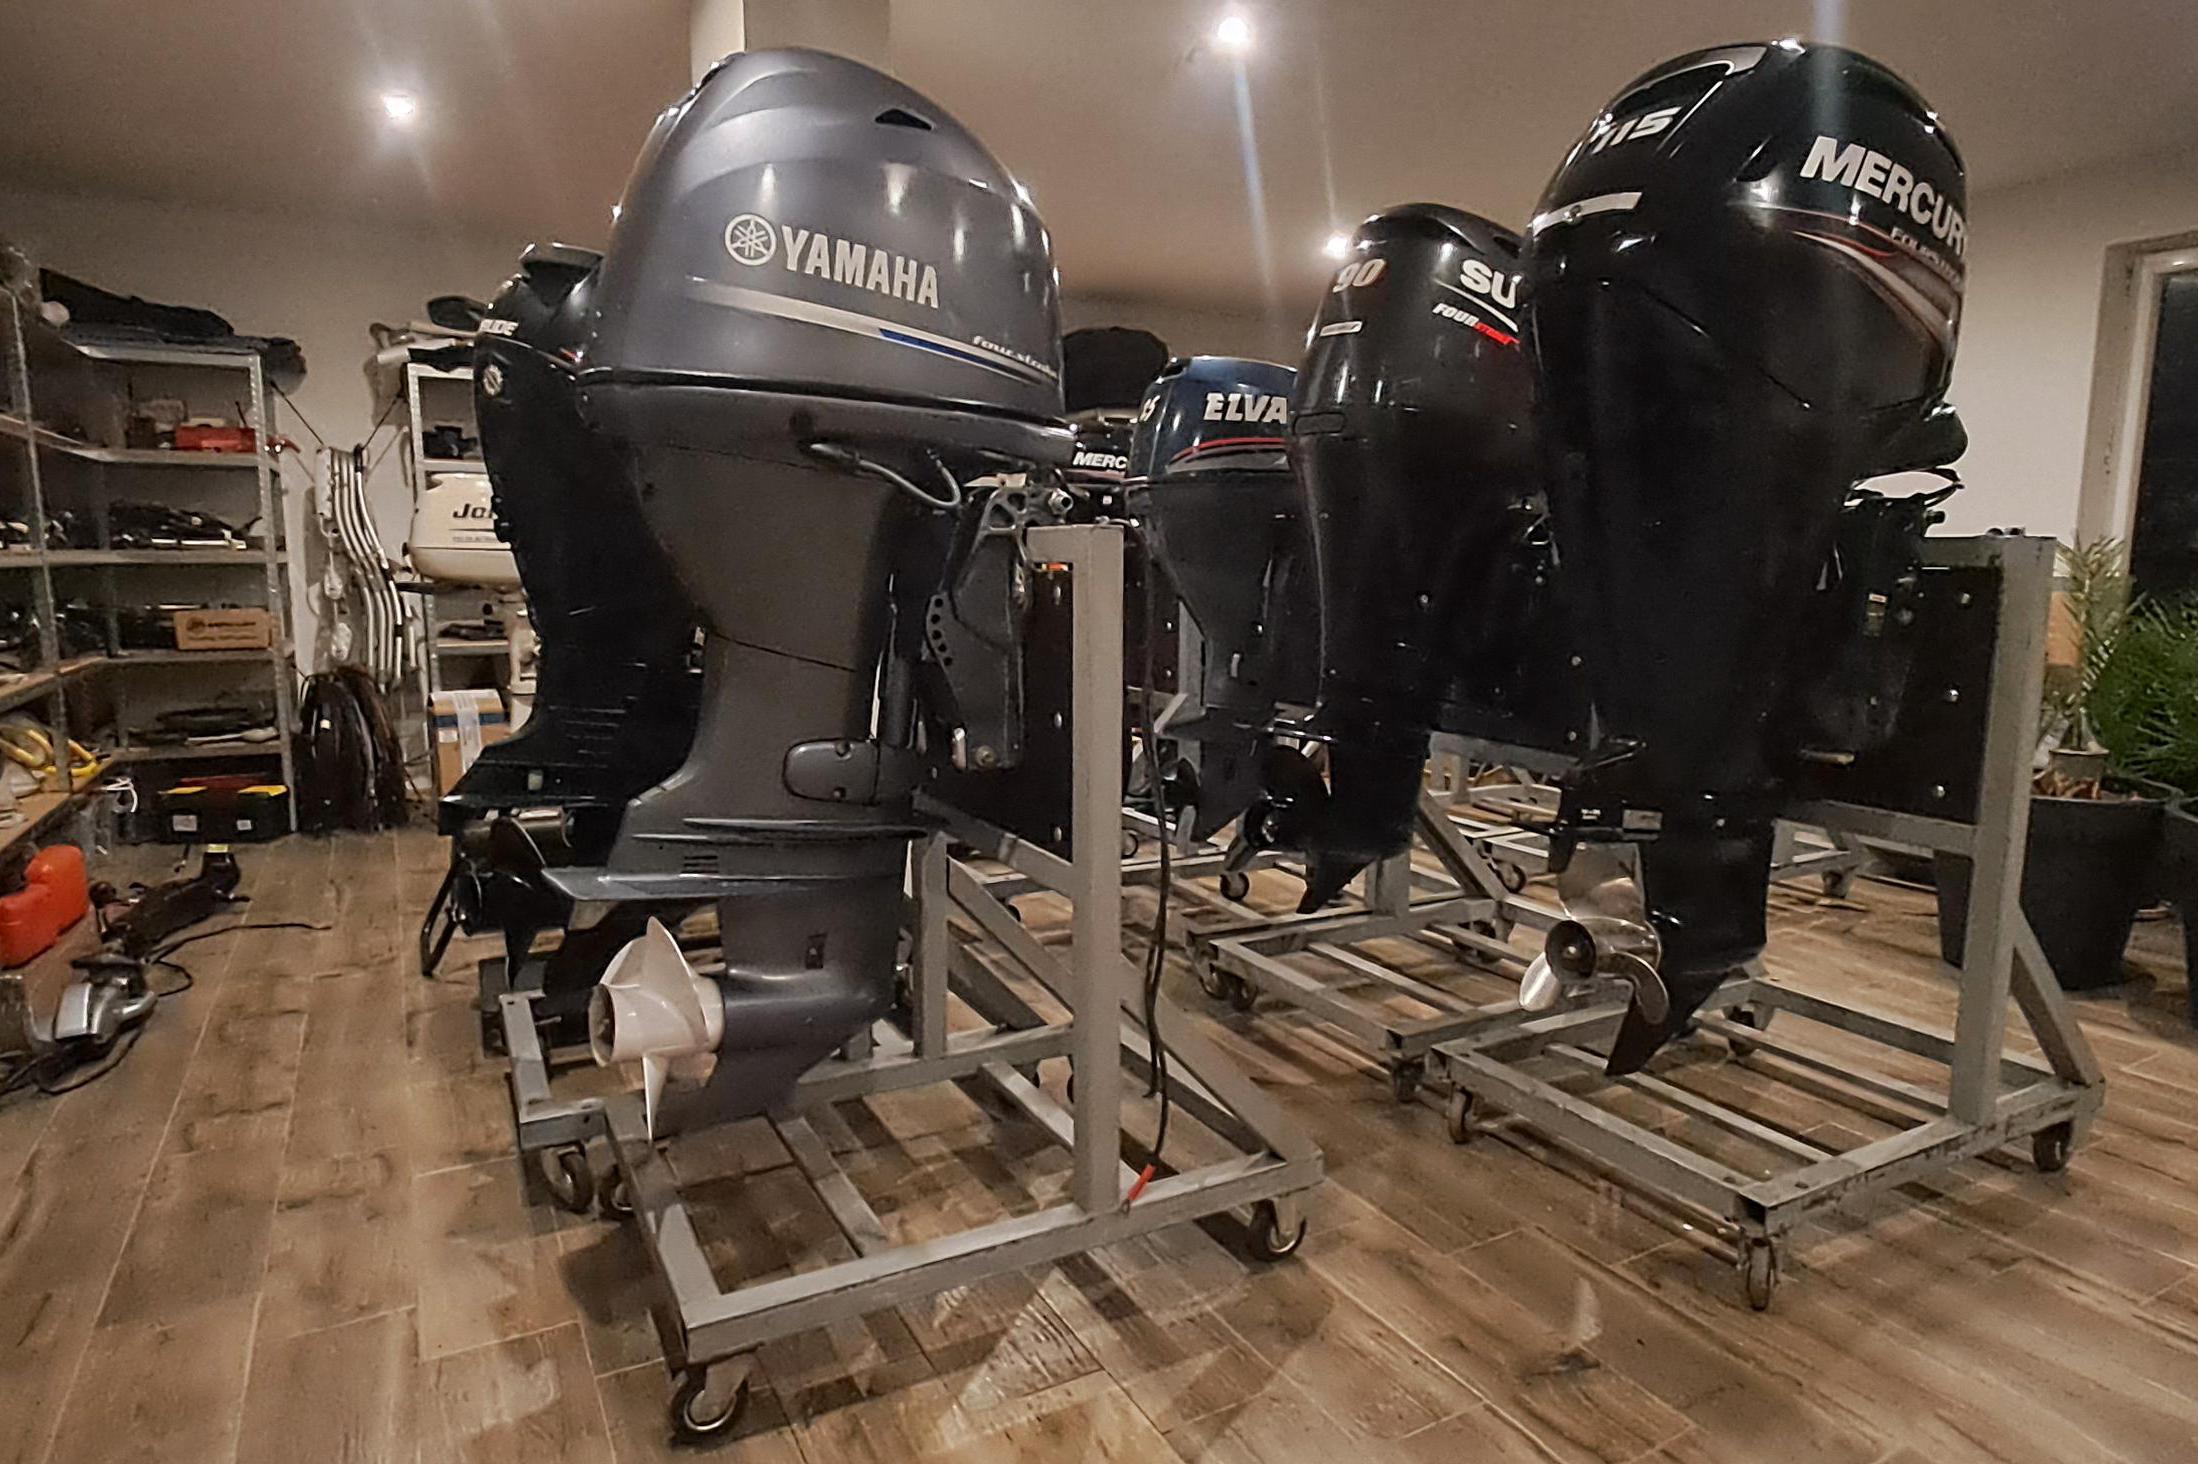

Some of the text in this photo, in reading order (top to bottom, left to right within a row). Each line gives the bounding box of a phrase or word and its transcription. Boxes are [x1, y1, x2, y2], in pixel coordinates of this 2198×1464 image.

[1801, 135, 1968, 257] MERCUR
[781, 225, 940, 309] YAMAHA
[1332, 258, 1387, 293] 90
[1203, 392, 1288, 424] ELVA
[1072, 451, 1128, 469] MERC
